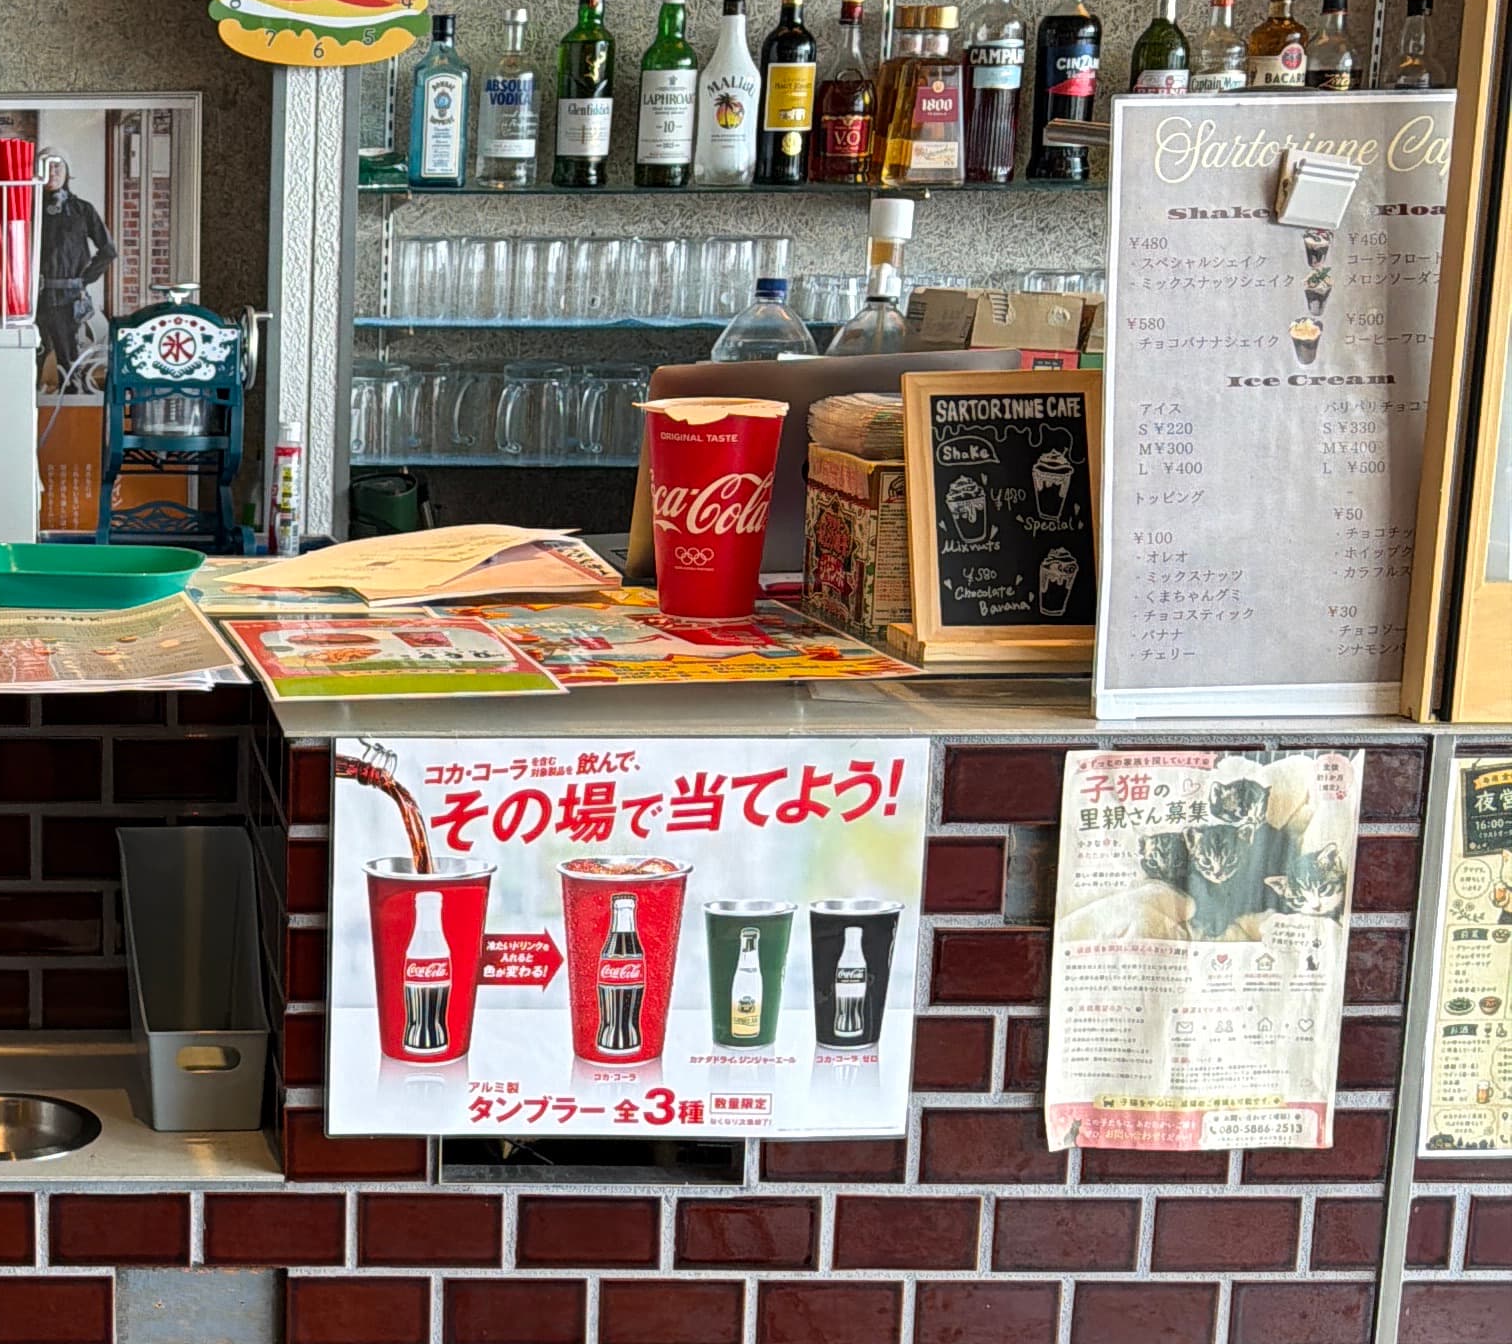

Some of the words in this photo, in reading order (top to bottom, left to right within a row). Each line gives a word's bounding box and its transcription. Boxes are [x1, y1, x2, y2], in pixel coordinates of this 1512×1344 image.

[265, 31, 276, 47] 7
[364, 29, 374, 45] 5
[314, 43, 324, 58] 6
[707, 75, 756, 98] MALIBU
[489, 92, 532, 106] VODKA
[922, 98, 953, 112] 1800
[663, 120, 675, 133] 10
[1167, 206, 1271, 220] Shake
[1129, 237, 1168, 250] ¥480
[1348, 232, 1388, 246] ¥450
[1141, 256, 1268, 270] スペシャルシェイク
[1141, 274, 1295, 290] ミックスナッツシェイク
[1127, 317, 1165, 331] ¥580
[1346, 313, 1385, 326] ¥500
[162, 331, 194, 363] 氷
[1138, 335, 1280, 350] チョコバナナシェイク
[1226, 374, 1280, 387] Ice
[1288, 372, 1397, 387] Cream
[935, 397, 1045, 423] SARTORINNE
[1046, 396, 1081, 418] CAFE
[1140, 402, 1182, 416] アイス
[1138, 423, 1148, 435] S
[1154, 422, 1193, 435] ¥220
[1323, 422, 1332, 435] S
[1338, 421, 1376, 434] ¥330
[660, 431, 703, 442] ORIGINAL
[706, 433, 739, 443] TASTE
[1139, 463, 1148, 475] L
[1163, 462, 1203, 475] ¥400
[1323, 462, 1332, 474] L
[650, 468, 775, 535] ca-Cola
[1135, 490, 1205, 505] トッピング
[1334, 508, 1363, 521] ¥50
[1133, 532, 1173, 545] ¥100
[1146, 551, 1188, 563] オレオ
[1147, 569, 1244, 582] ミックスナッツ
[954, 585, 1015, 601] Chocolate
[1145, 588, 1241, 602] くまちゃんグミ
[979, 600, 1031, 617] Banana
[1143, 608, 1255, 622] チョコスティック
[1328, 606, 1357, 618] ¥30
[1141, 647, 1196, 661] チェリー
[424, 758, 528, 785] コカ・コーラ
[1079, 773, 1170, 804] 子猫の
[1078, 800, 1210, 832] 里親さん募集
[500, 952, 534, 963] 入れると
[406, 962, 449, 978] Coca-Cola
[600, 962, 643, 979] Coca-Cola
[468, 1082, 520, 1094] アルミ製
[468, 1095, 606, 1125] タンブラー
[613, 1087, 705, 1126] 全3種
[715, 1097, 767, 1111] 数量限定
